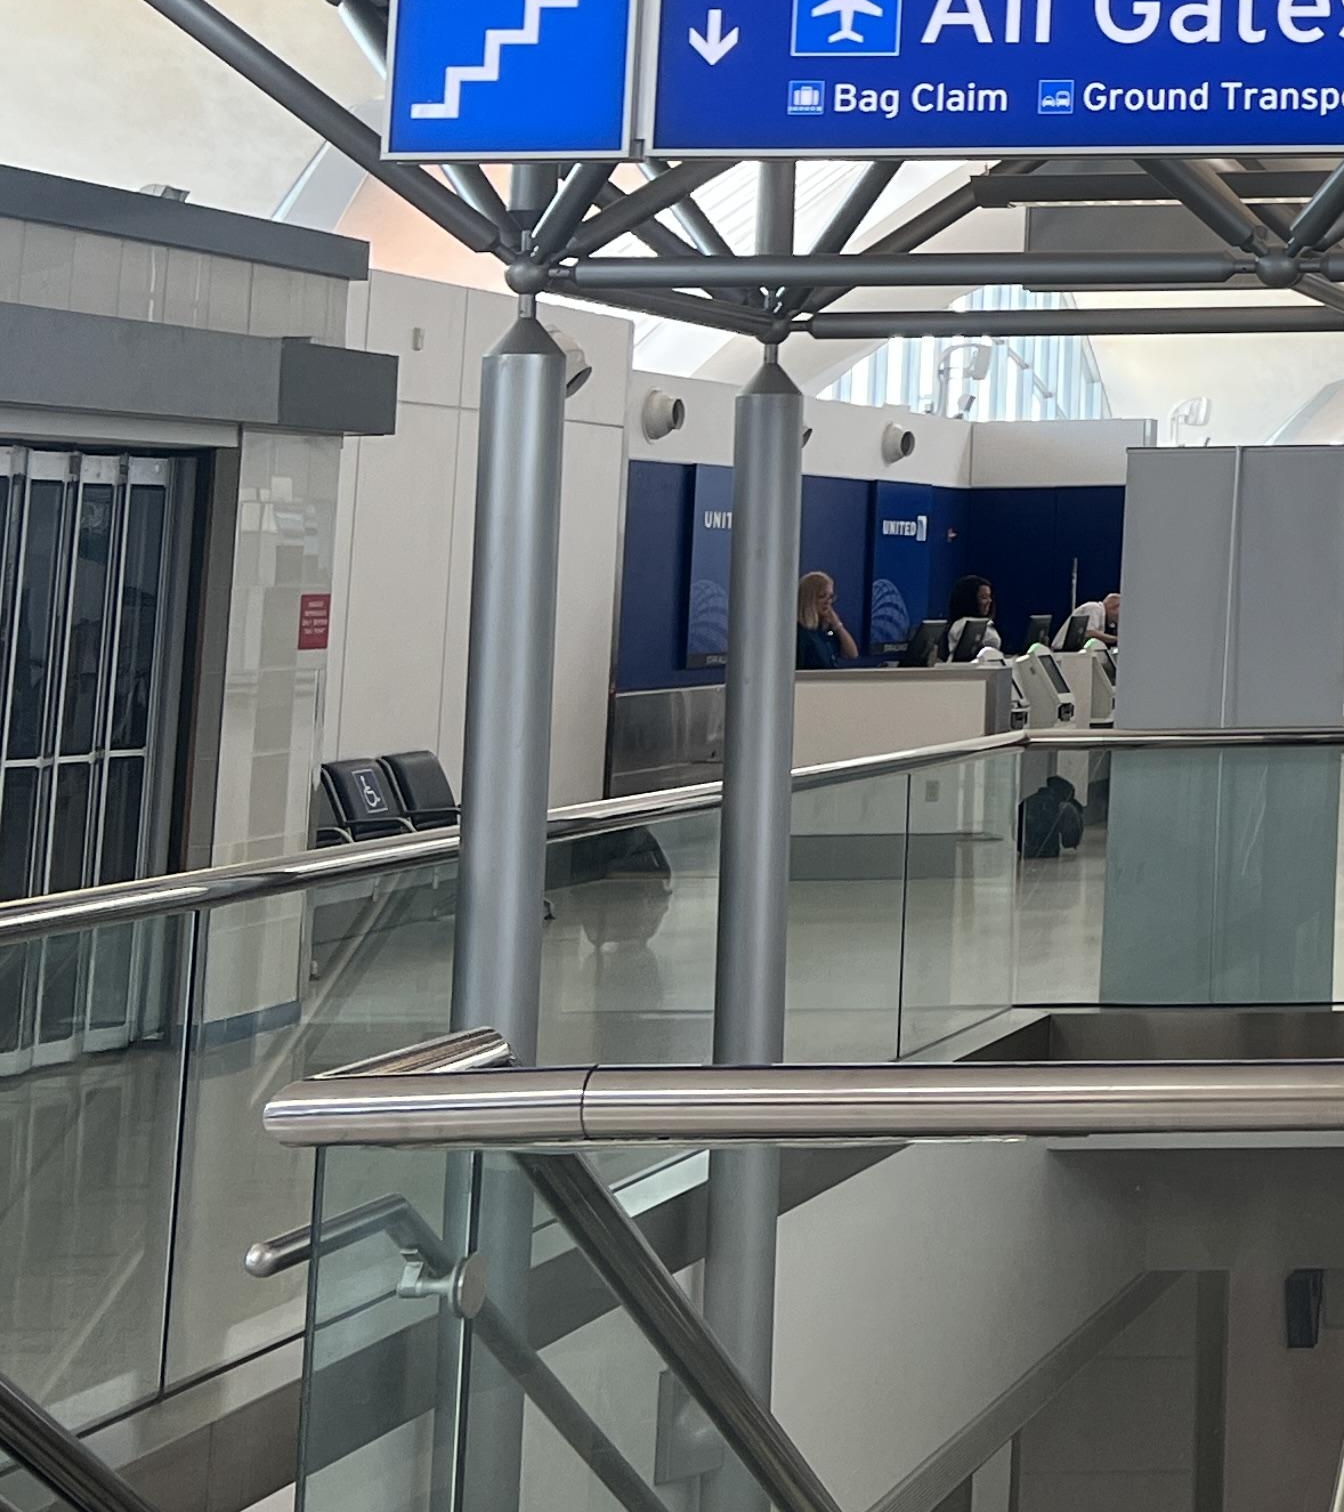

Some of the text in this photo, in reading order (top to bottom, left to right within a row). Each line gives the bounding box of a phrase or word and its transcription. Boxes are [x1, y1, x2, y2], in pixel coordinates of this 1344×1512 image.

[834, 83, 899, 119] Bag
[910, 81, 1008, 113] Claim
[1082, 81, 1208, 112] Ground
[883, 520, 917, 536] UNITED
